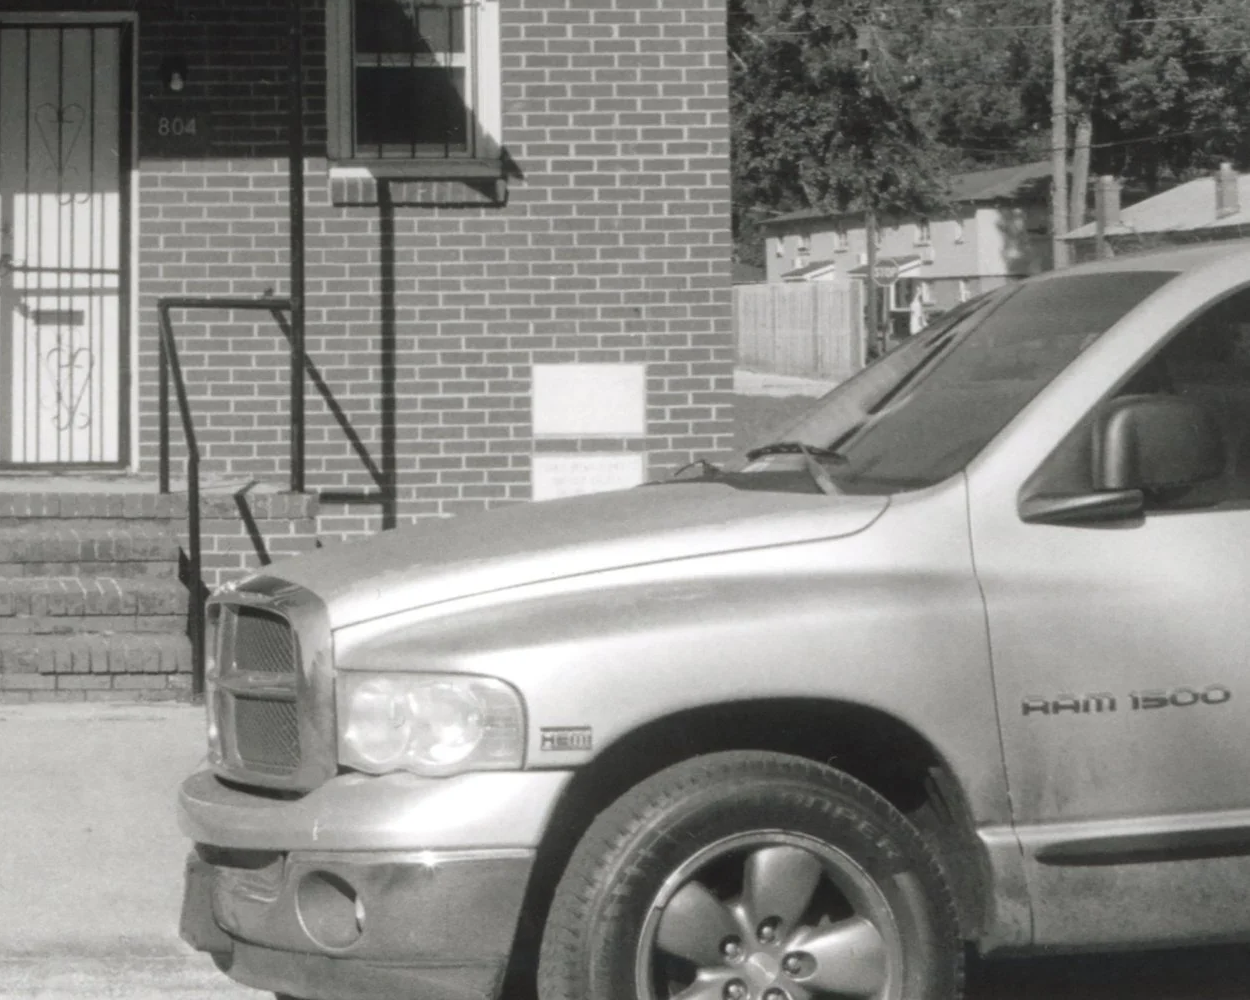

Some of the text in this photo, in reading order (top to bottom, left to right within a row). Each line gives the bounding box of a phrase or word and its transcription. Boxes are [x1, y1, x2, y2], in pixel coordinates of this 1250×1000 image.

[158, 116, 197, 136] 804
[873, 267, 897, 278] STOP
[1021, 683, 1232, 716] RAM 1500
